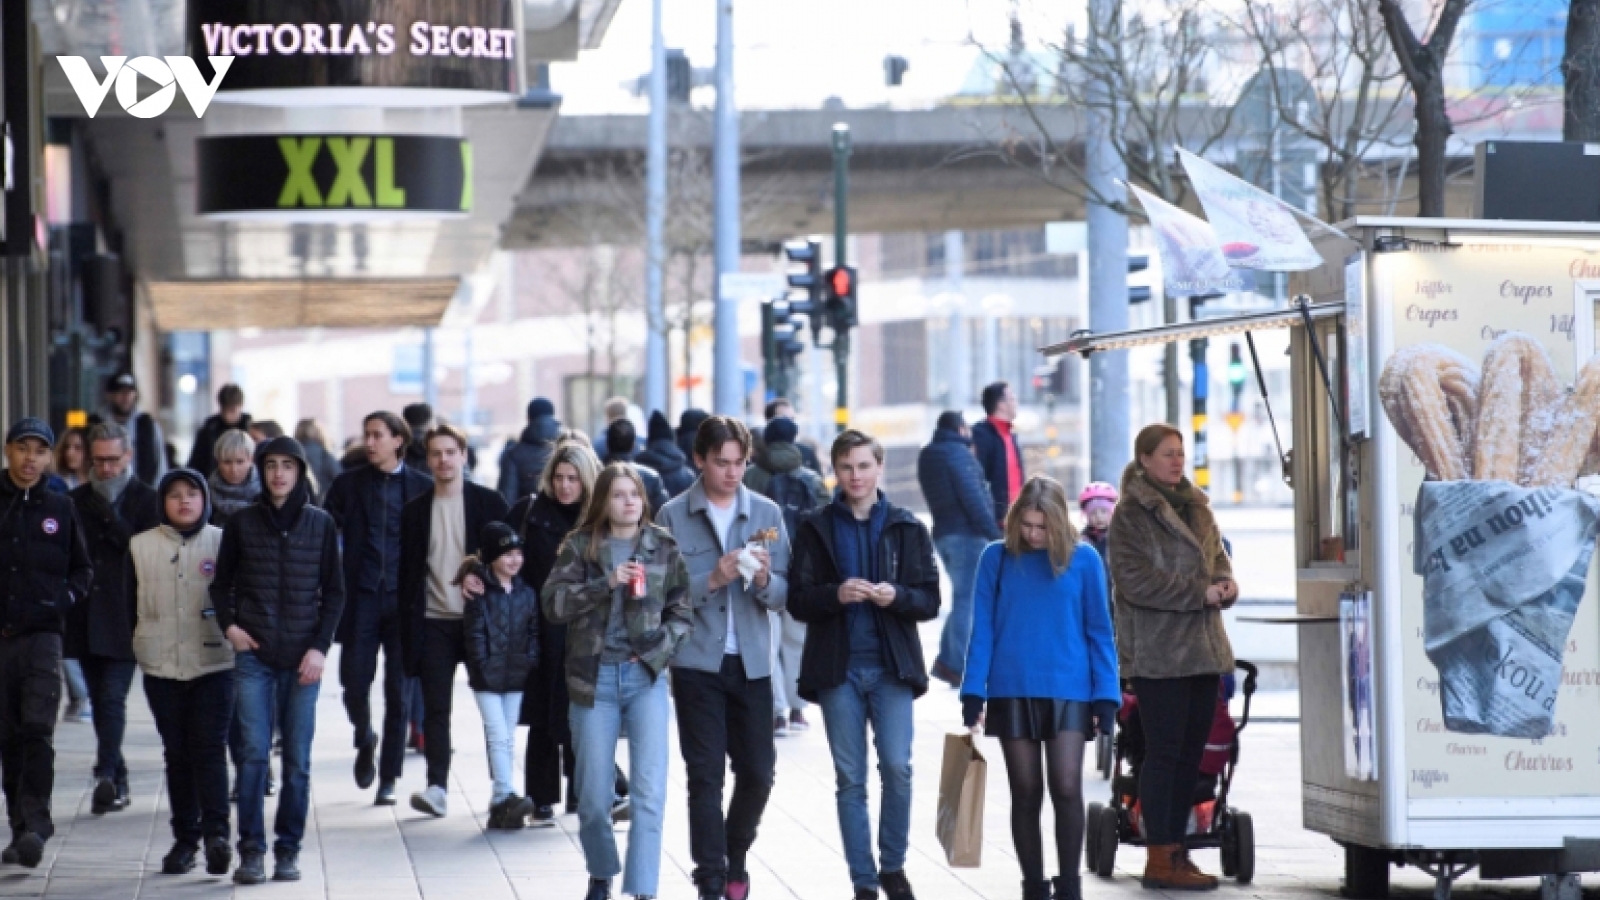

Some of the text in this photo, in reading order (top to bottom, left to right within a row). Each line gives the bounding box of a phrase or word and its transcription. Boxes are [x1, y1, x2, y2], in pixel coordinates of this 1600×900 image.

[201, 20, 516, 59] VICTORIA'S SECRET
[276, 136, 406, 208] XXL
[1500, 279, 1553, 305] Crepes
